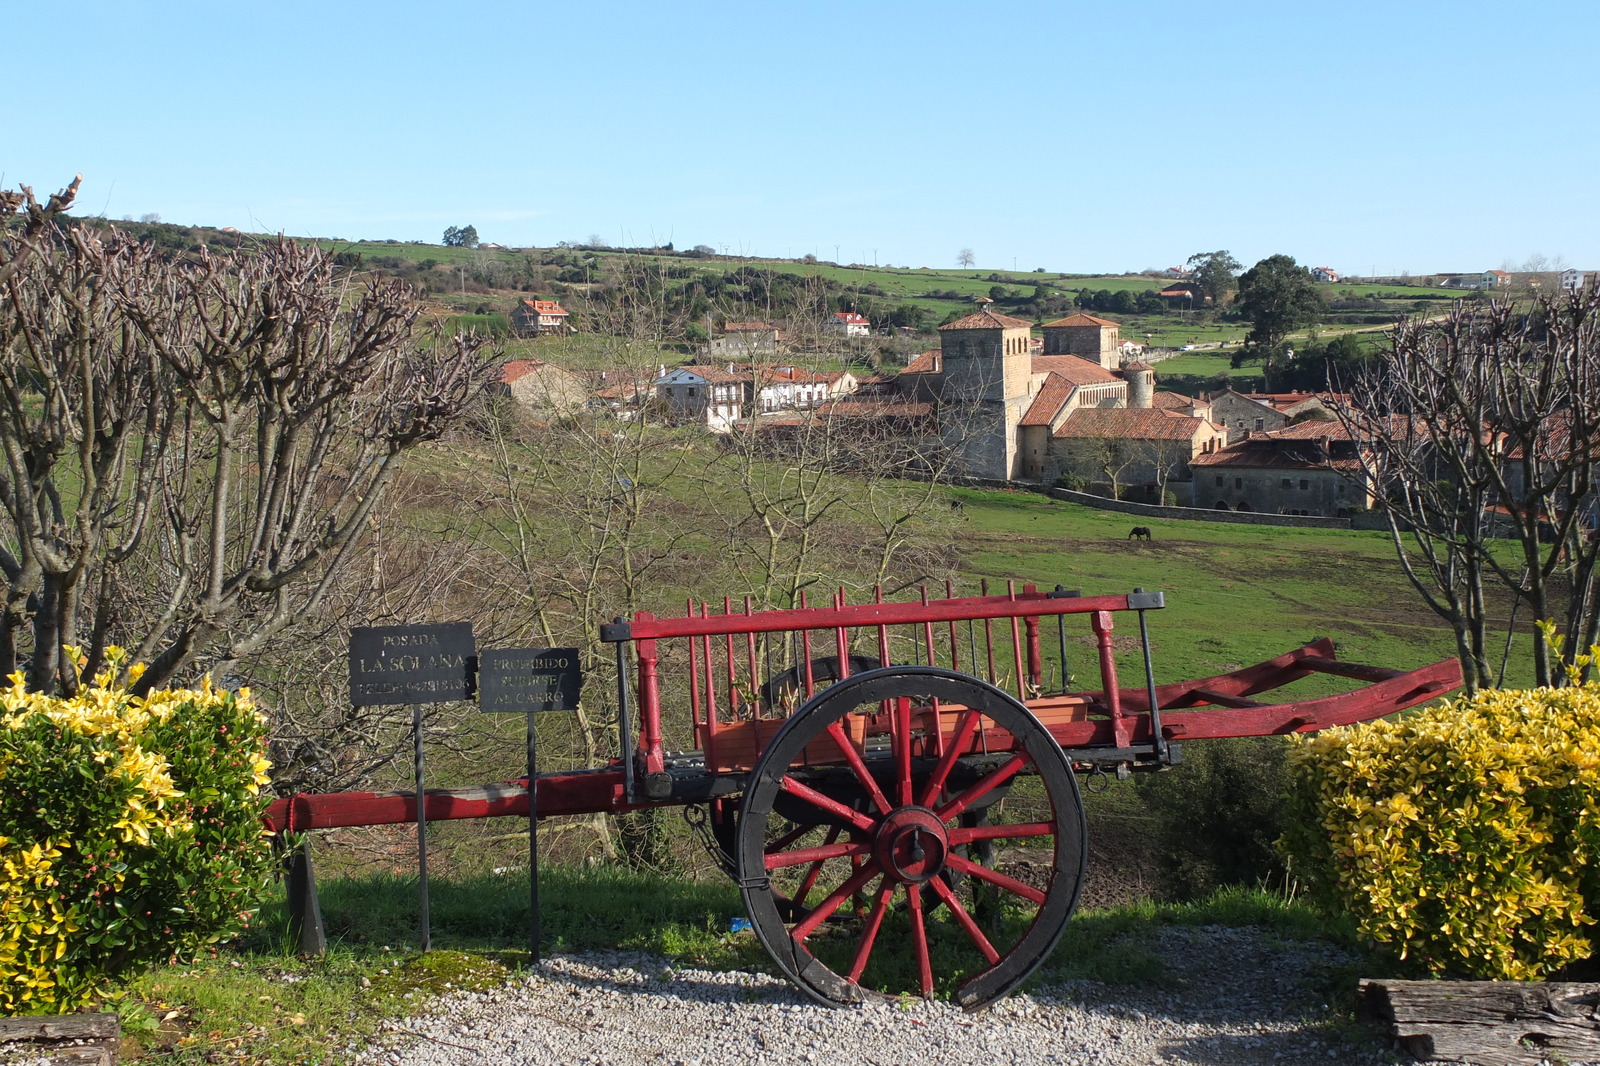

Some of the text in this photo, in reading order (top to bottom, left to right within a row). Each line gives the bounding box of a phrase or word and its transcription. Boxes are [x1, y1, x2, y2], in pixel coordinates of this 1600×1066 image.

[383, 634, 439, 646] POSADA
[360, 653, 466, 673] LA SOLANA
[493, 658, 569, 670] PROHIBIDO
[501, 674, 558, 687] SUBIRSE
[494, 691, 564, 705] AL CARRO
